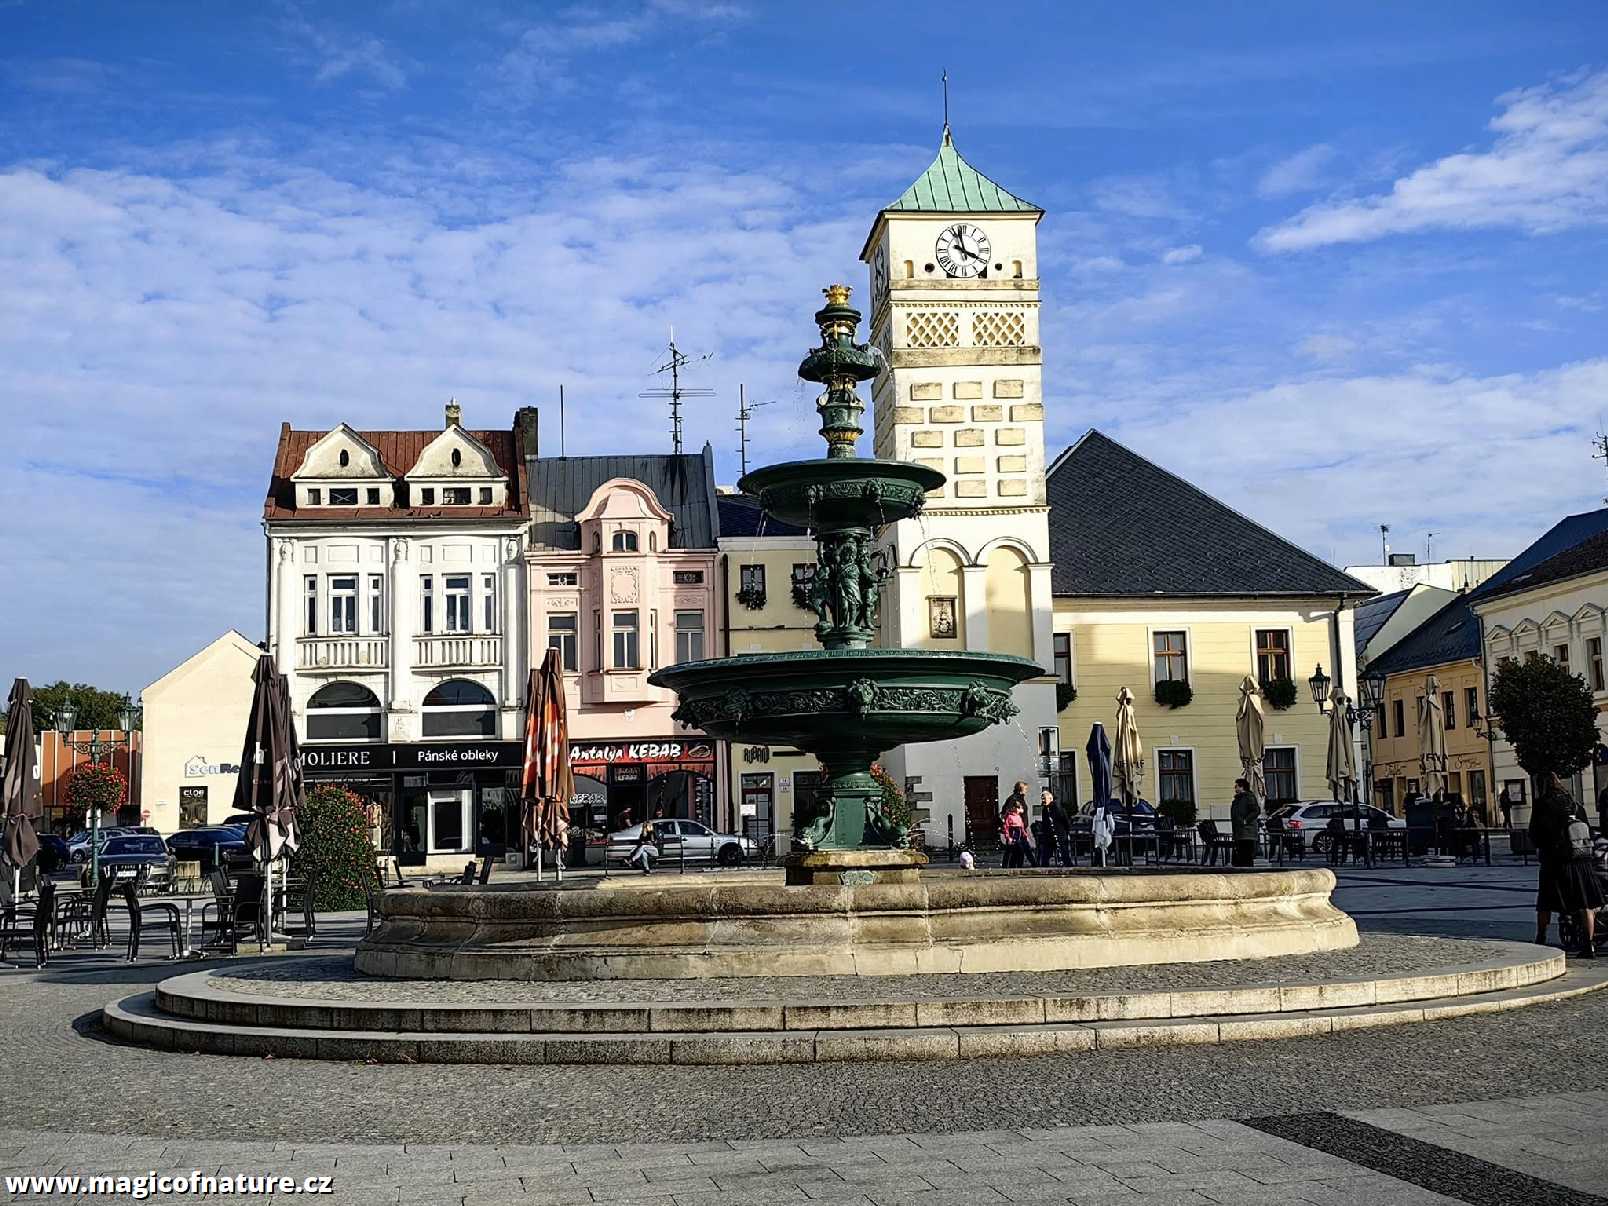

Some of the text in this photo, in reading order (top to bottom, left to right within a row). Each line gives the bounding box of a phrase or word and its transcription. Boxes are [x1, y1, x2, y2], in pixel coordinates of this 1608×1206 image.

[417, 749, 499, 763] Pánské obleky
[570, 743, 681, 762] Antalya KEBAB
